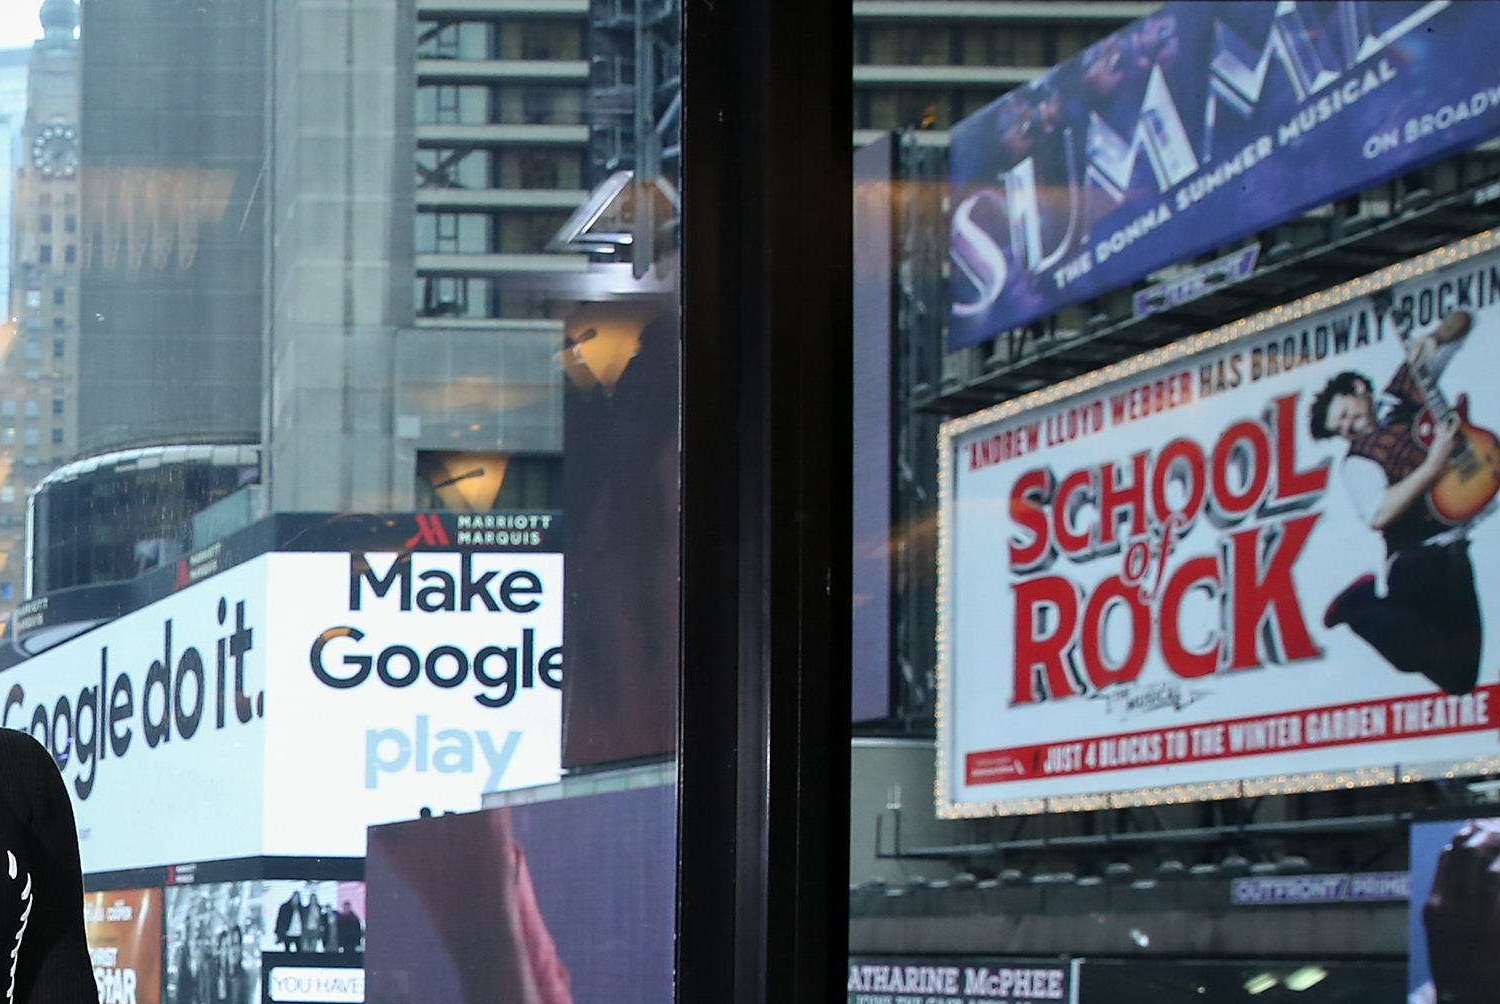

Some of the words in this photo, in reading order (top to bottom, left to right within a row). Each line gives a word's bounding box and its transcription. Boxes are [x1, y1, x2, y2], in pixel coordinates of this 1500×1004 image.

[1053, 251, 1093, 288] THE
[1095, 202, 1172, 263] DONNA
[1175, 134, 1273, 212] SUMMER
[1277, 58, 1397, 147] MUSICAL
[1362, 128, 1399, 160] ON
[1047, 401, 1105, 447] LLOYD
[1110, 371, 1192, 427] WEBBER
[1199, 354, 1242, 399] HAS
[1251, 304, 1389, 383] BROADWAY
[457, 514, 552, 530] MARRIOTT
[1008, 392, 1331, 575] SCHOOL
[457, 530, 541, 546] MARQUIS
[1122, 514, 1188, 600] of
[349, 552, 543, 613] Make
[1008, 512, 1325, 708] ROCK
[142, 618, 205, 749] do
[215, 596, 264, 731] it.
[311, 627, 564, 708] Google
[364, 713, 523, 790] play
[1043, 743, 1083, 775] JUST
[1084, 742, 1096, 770] 4
[1101, 733, 1163, 769] BLOCKS
[1164, 729, 1189, 760] TO
[1191, 724, 1226, 757] THE
[1228, 714, 1301, 753] WINTER
[1304, 704, 1387, 744] GARDEN
[1390, 690, 1491, 735] THEATRE
[273, 976, 312, 993] YOU
[848, 964, 960, 994] ATHARINE
[964, 967, 1064, 998] McPHEE
